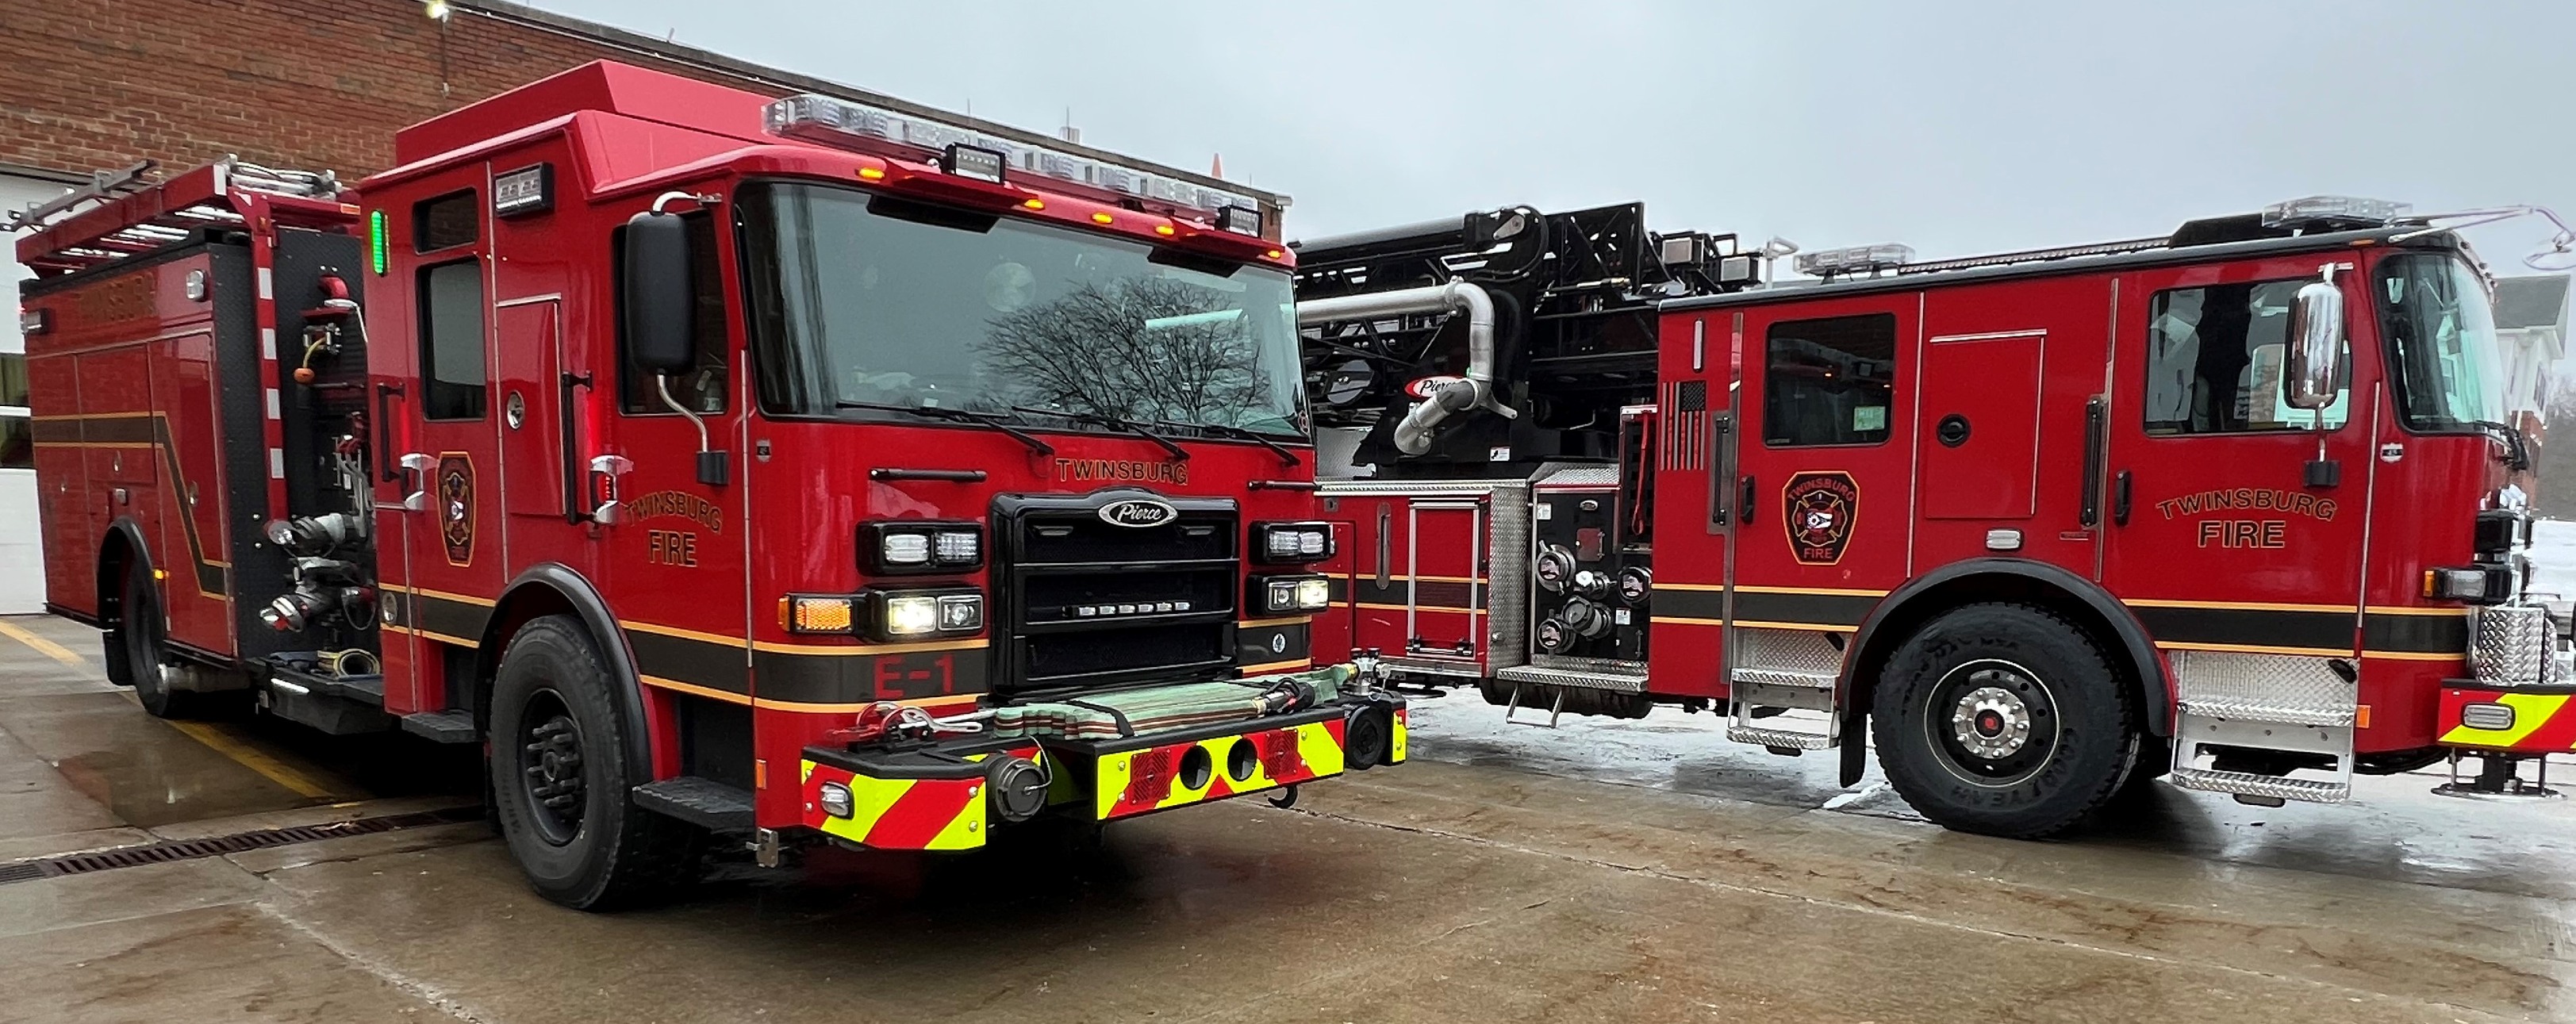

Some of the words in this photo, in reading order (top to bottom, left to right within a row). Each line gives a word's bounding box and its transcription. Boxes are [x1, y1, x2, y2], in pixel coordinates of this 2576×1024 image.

[1419, 380, 1457, 395] Pier
[1056, 458, 1188, 486] TWINSBURG
[1787, 477, 1856, 502] TWINSBURG
[625, 489, 723, 535] TWINSBURG
[1116, 503, 1162, 524] Pierce
[2156, 488, 2338, 522] TWINSBURG
[648, 529, 697, 567] FIRE
[2198, 520, 2286, 548] FIRE
[1803, 547, 1834, 559] FIRE
[874, 654, 954, 699] E-1
